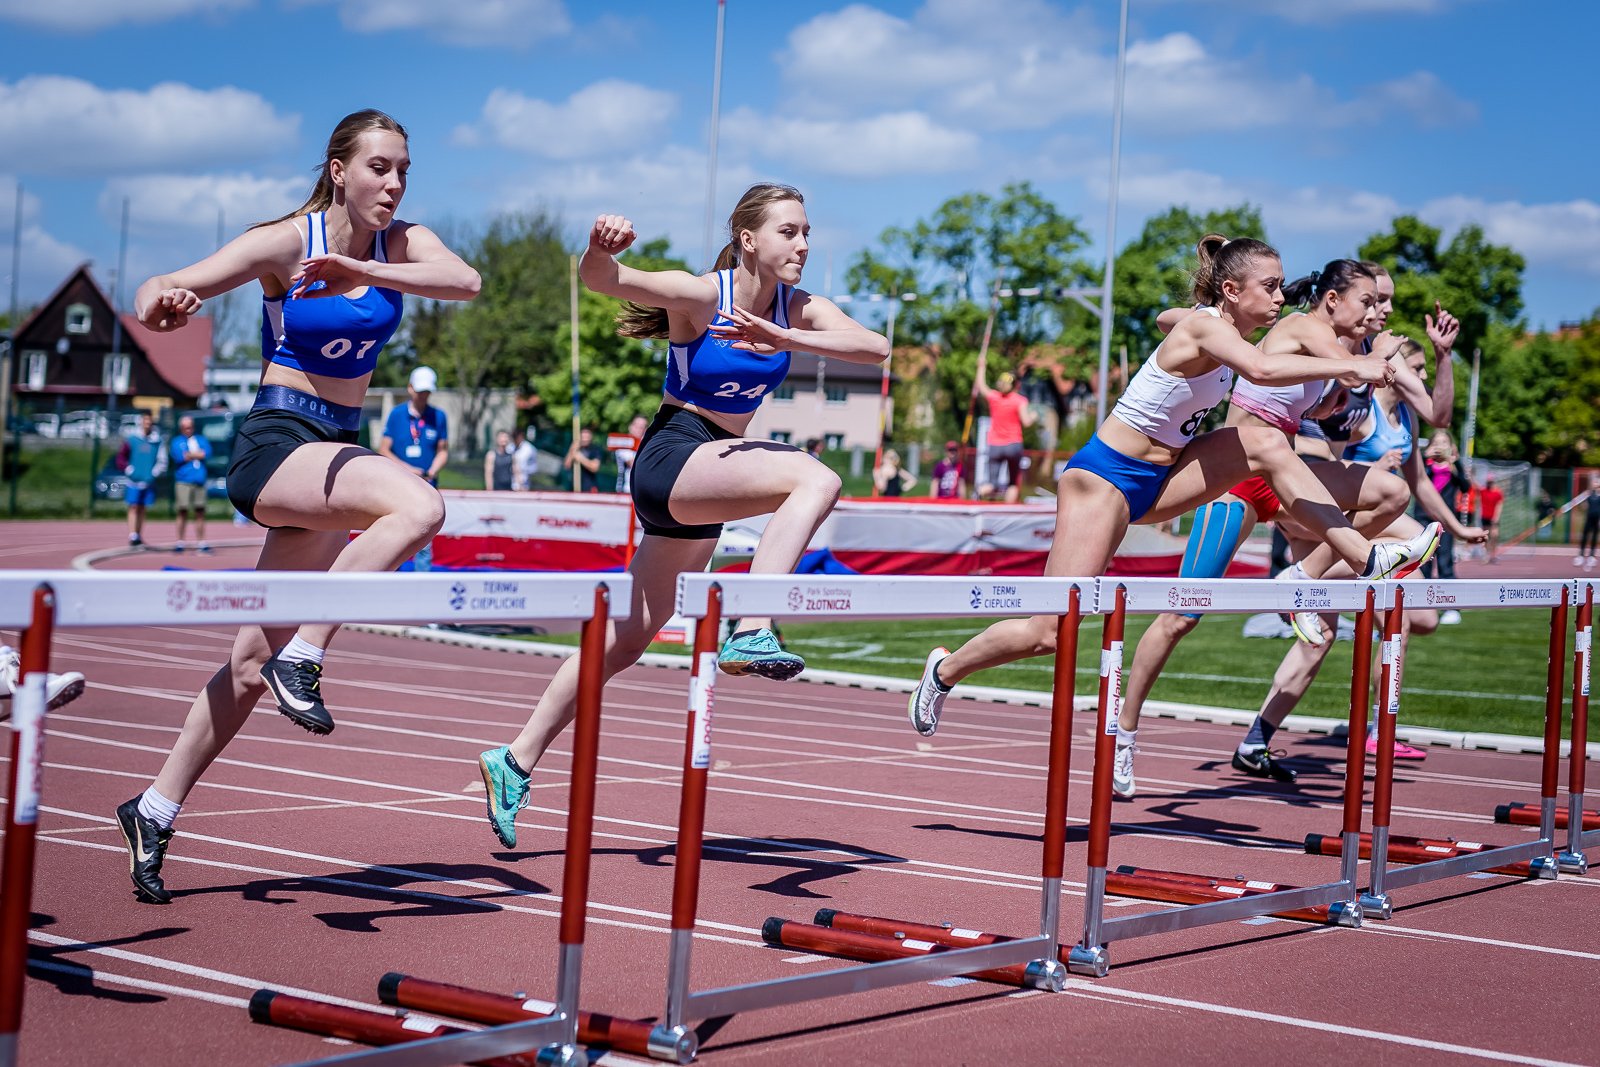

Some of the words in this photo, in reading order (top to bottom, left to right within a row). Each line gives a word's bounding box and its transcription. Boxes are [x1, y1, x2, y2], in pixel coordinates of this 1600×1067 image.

[321, 338, 377, 360] 07
[713, 381, 768, 399] 24
[288, 394, 335, 418] SPOR
[992, 585, 1017, 596] TERMY
[1310, 588, 1328, 597] TERMY
[1507, 589, 1524, 600] TERMY
[1524, 588, 1552, 599] CIEPLICKIE
[805, 599, 852, 611] ZŁOTNICZA
[984, 598, 1022, 609] CIEPLICKIE
[1180, 597, 1212, 607] ZŁOTNICZA
[1304, 599, 1332, 608] CIEPLICKIE
